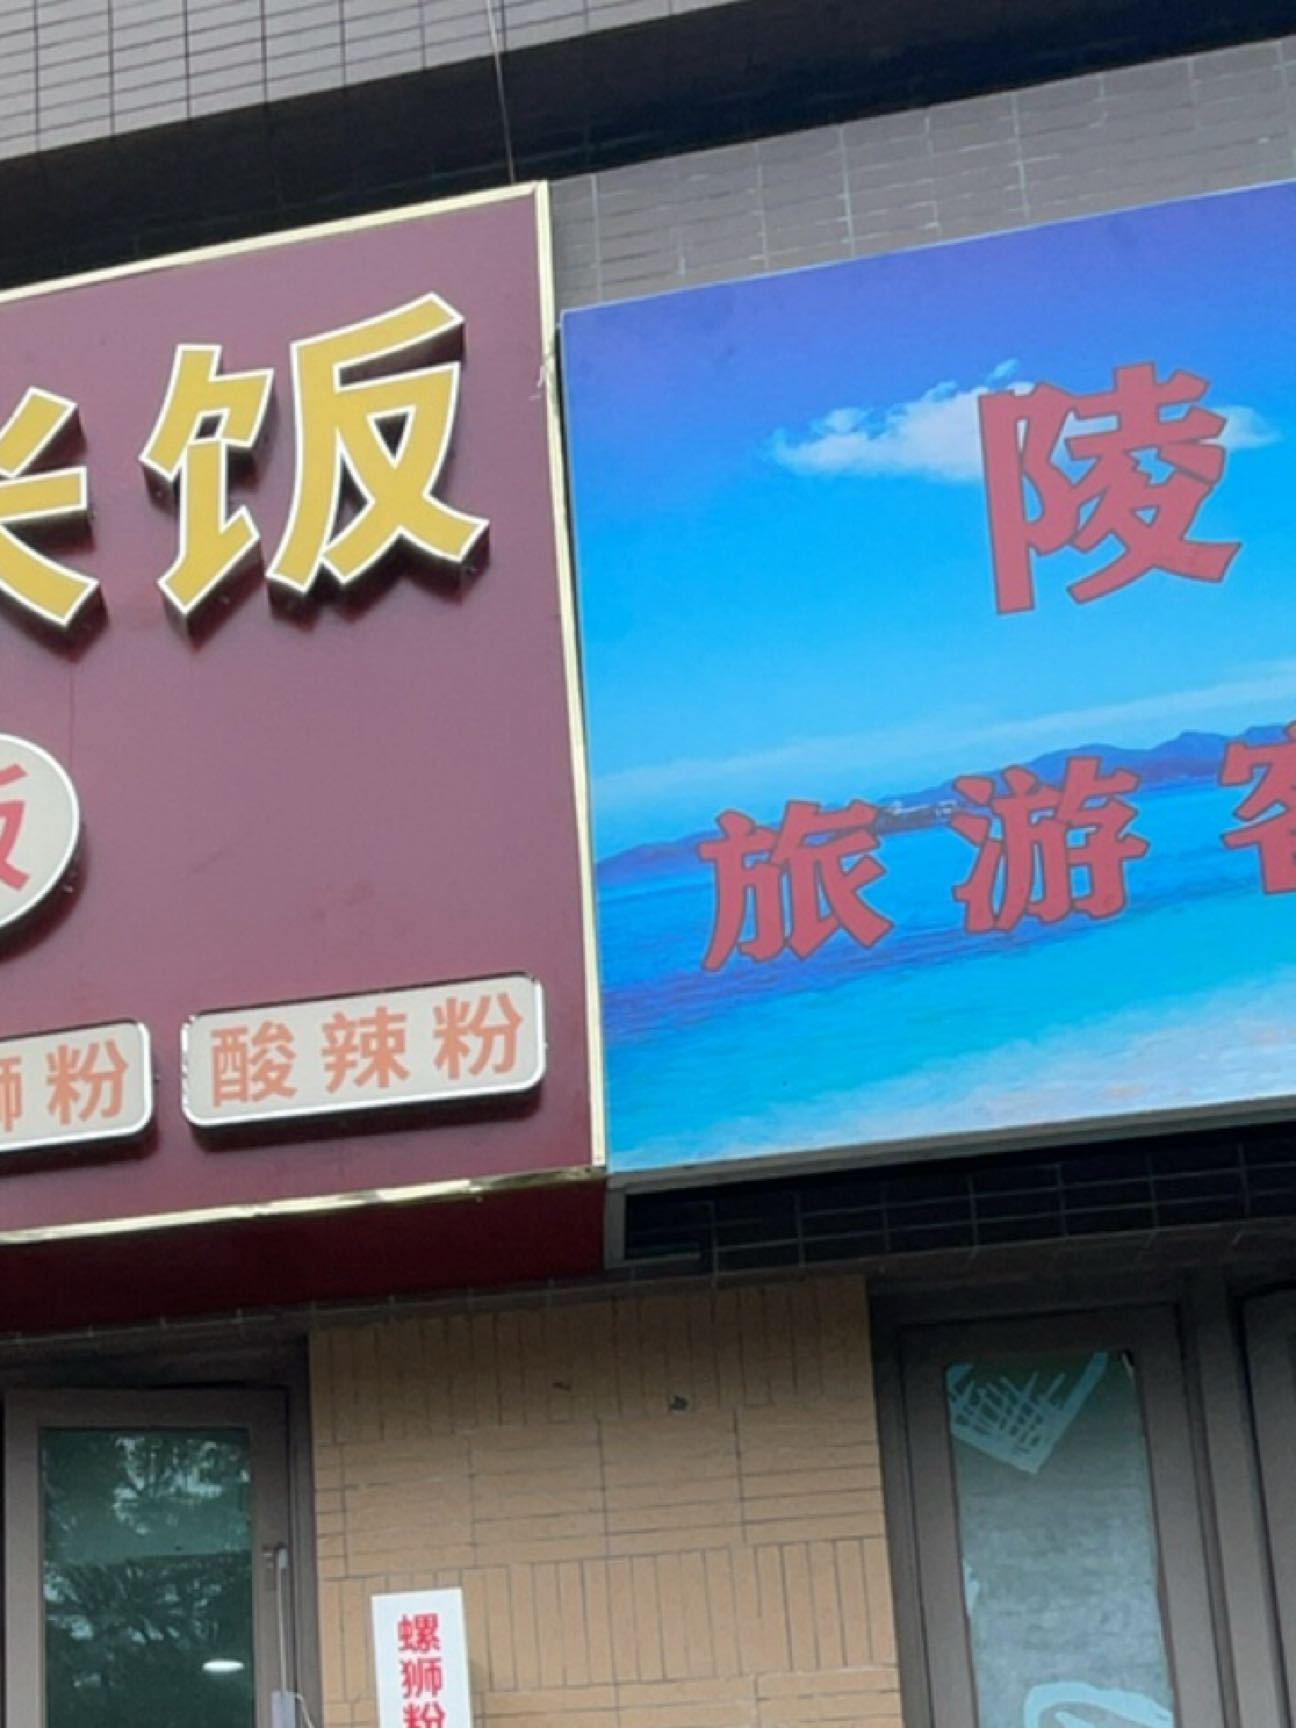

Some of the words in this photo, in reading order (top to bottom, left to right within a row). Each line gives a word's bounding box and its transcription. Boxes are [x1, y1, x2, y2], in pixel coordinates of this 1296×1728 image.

[978, 362, 1242, 614] 陵
[210, 992, 523, 1107] 酸辣粉
